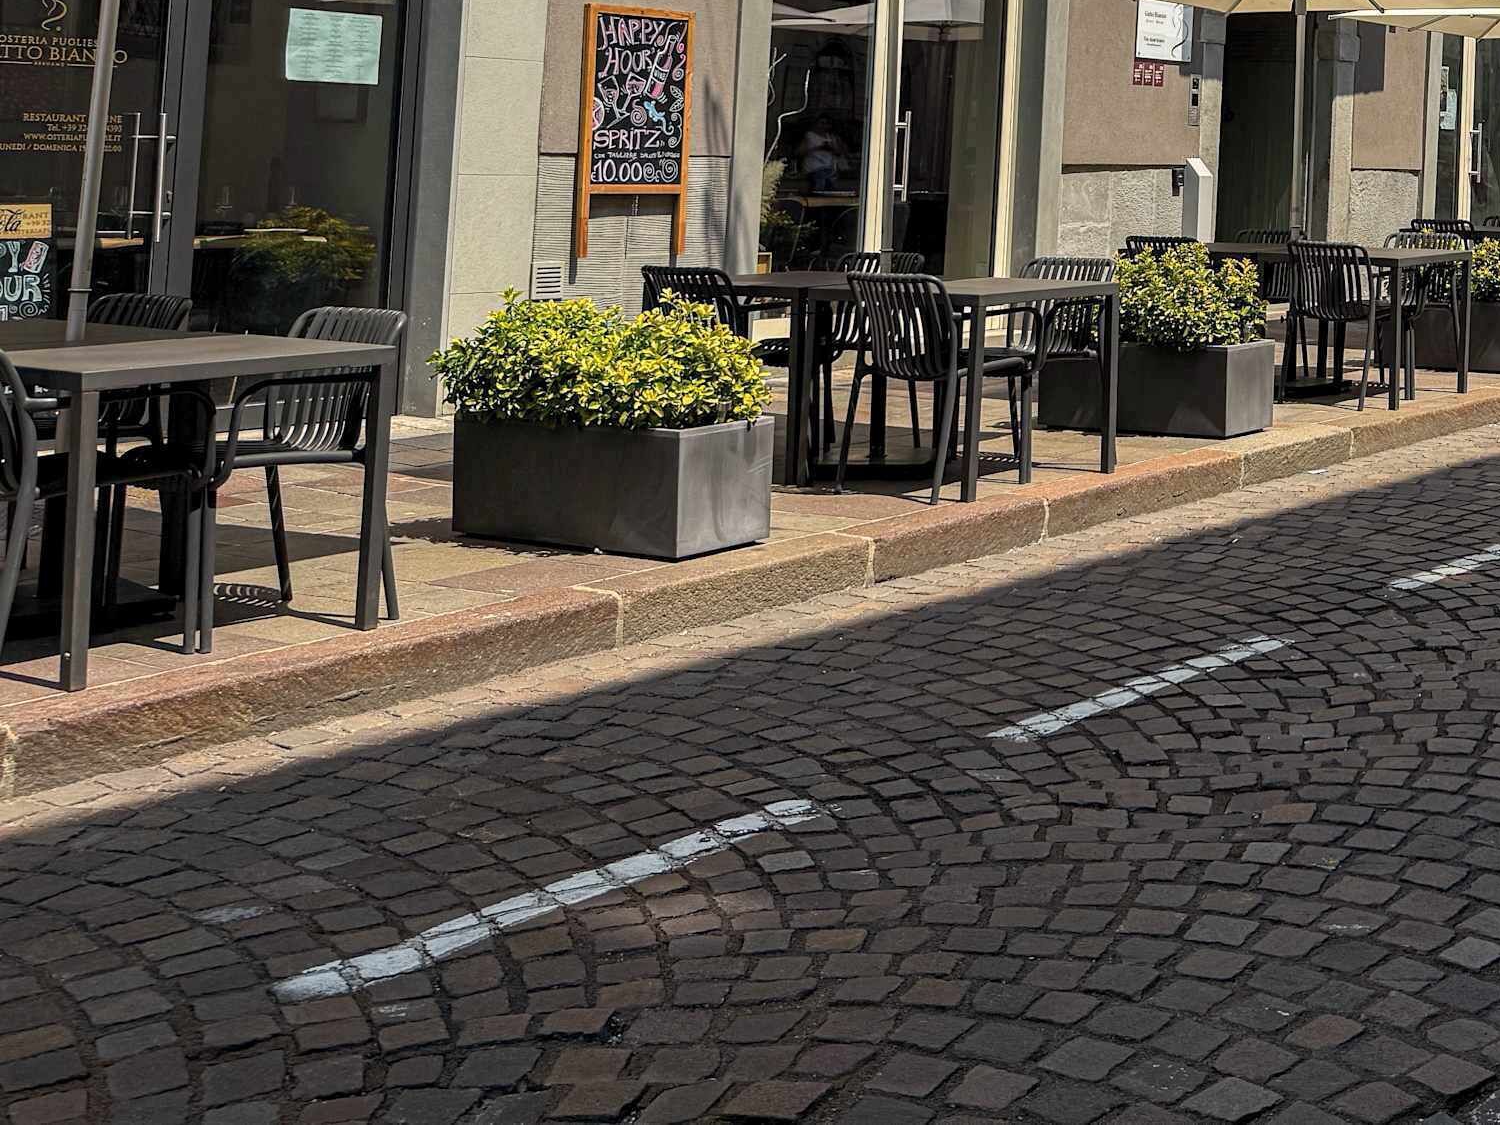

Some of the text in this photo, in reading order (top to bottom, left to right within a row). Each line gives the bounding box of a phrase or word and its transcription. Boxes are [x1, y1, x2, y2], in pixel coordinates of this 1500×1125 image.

[53, 36, 97, 47] PUGLIES
[597, 16, 666, 50] HAPPY
[0, 44, 128, 64] TTO BIANO
[598, 46, 653, 78] HOUR
[23, 113, 87, 123] RESTAURANT
[593, 128, 661, 150] SPRITZ
